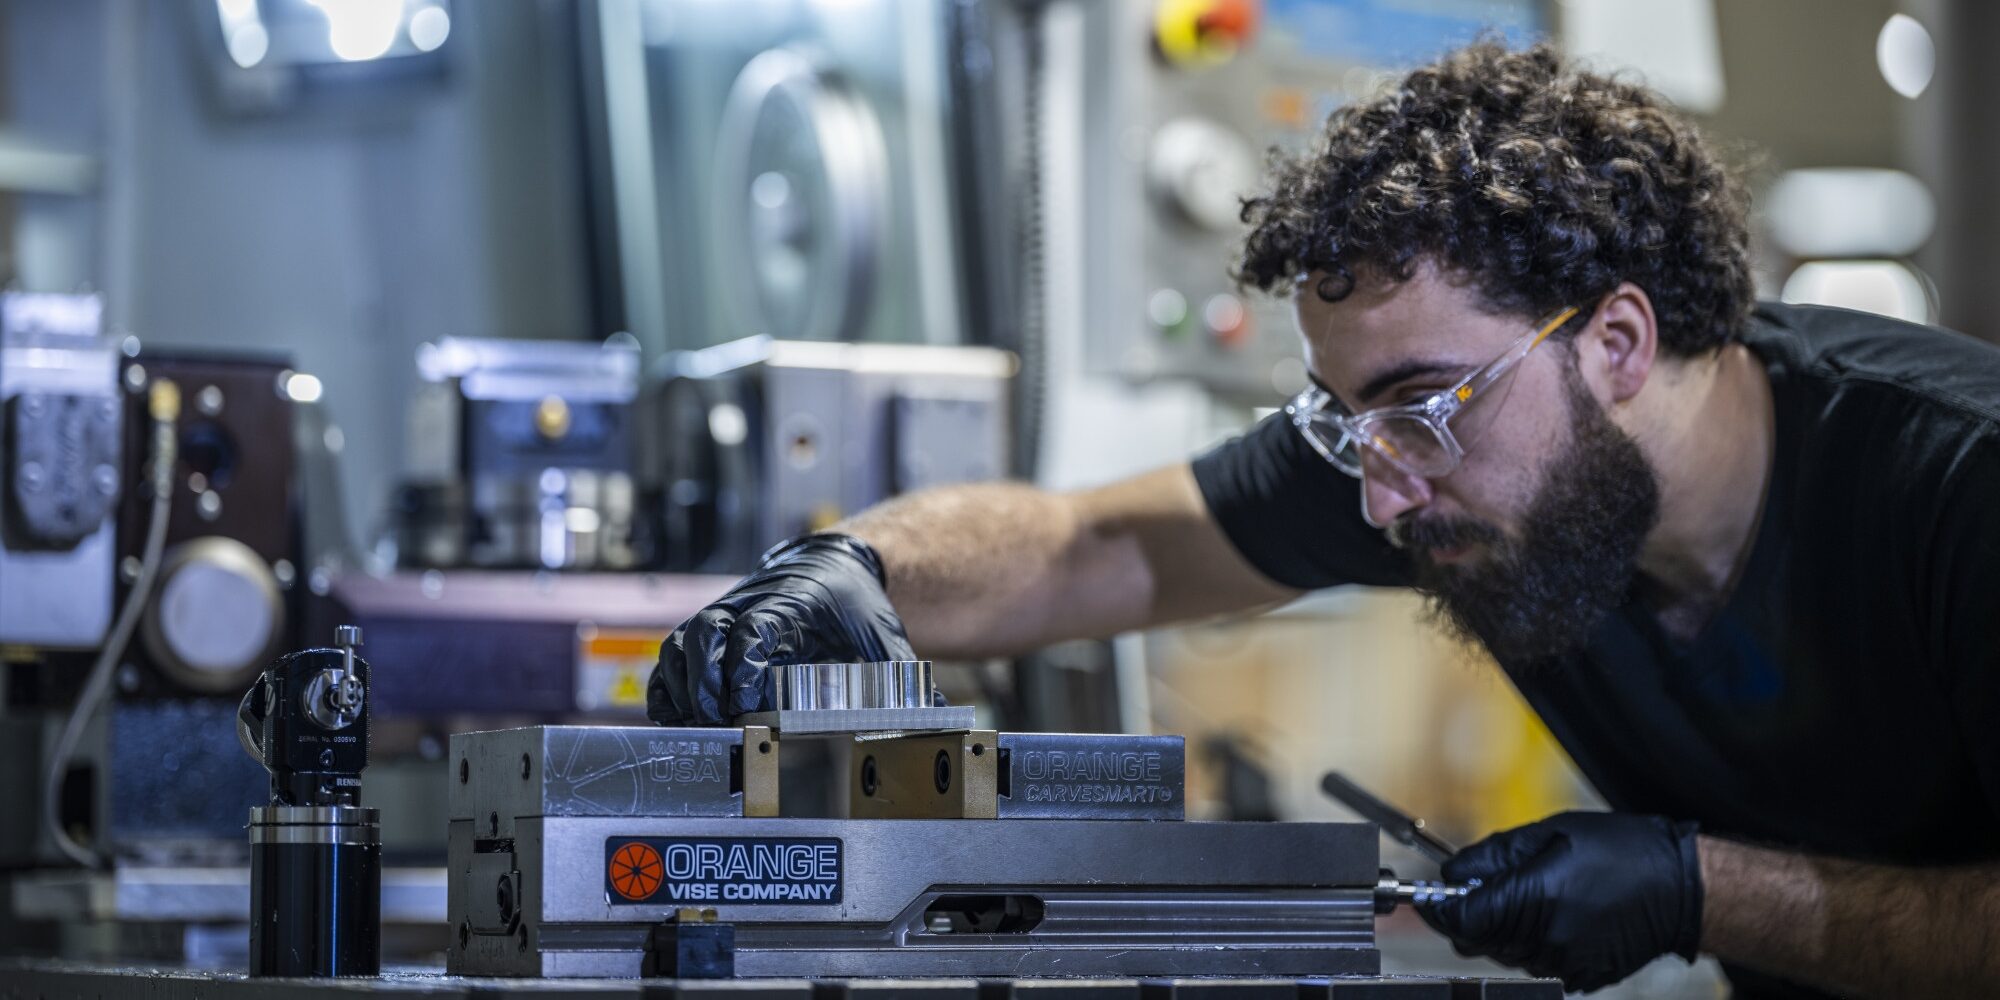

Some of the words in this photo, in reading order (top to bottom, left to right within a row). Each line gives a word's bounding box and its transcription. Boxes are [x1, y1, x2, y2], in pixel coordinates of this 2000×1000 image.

[649, 741, 700, 756] MADE
[703, 741, 722, 756] IN
[650, 757, 720, 783] USA
[1023, 750, 1161, 782] ORANGE
[665, 844, 838, 881] ORANGE
[668, 883, 719, 900] VISE
[723, 883, 837, 900] COMPANY
